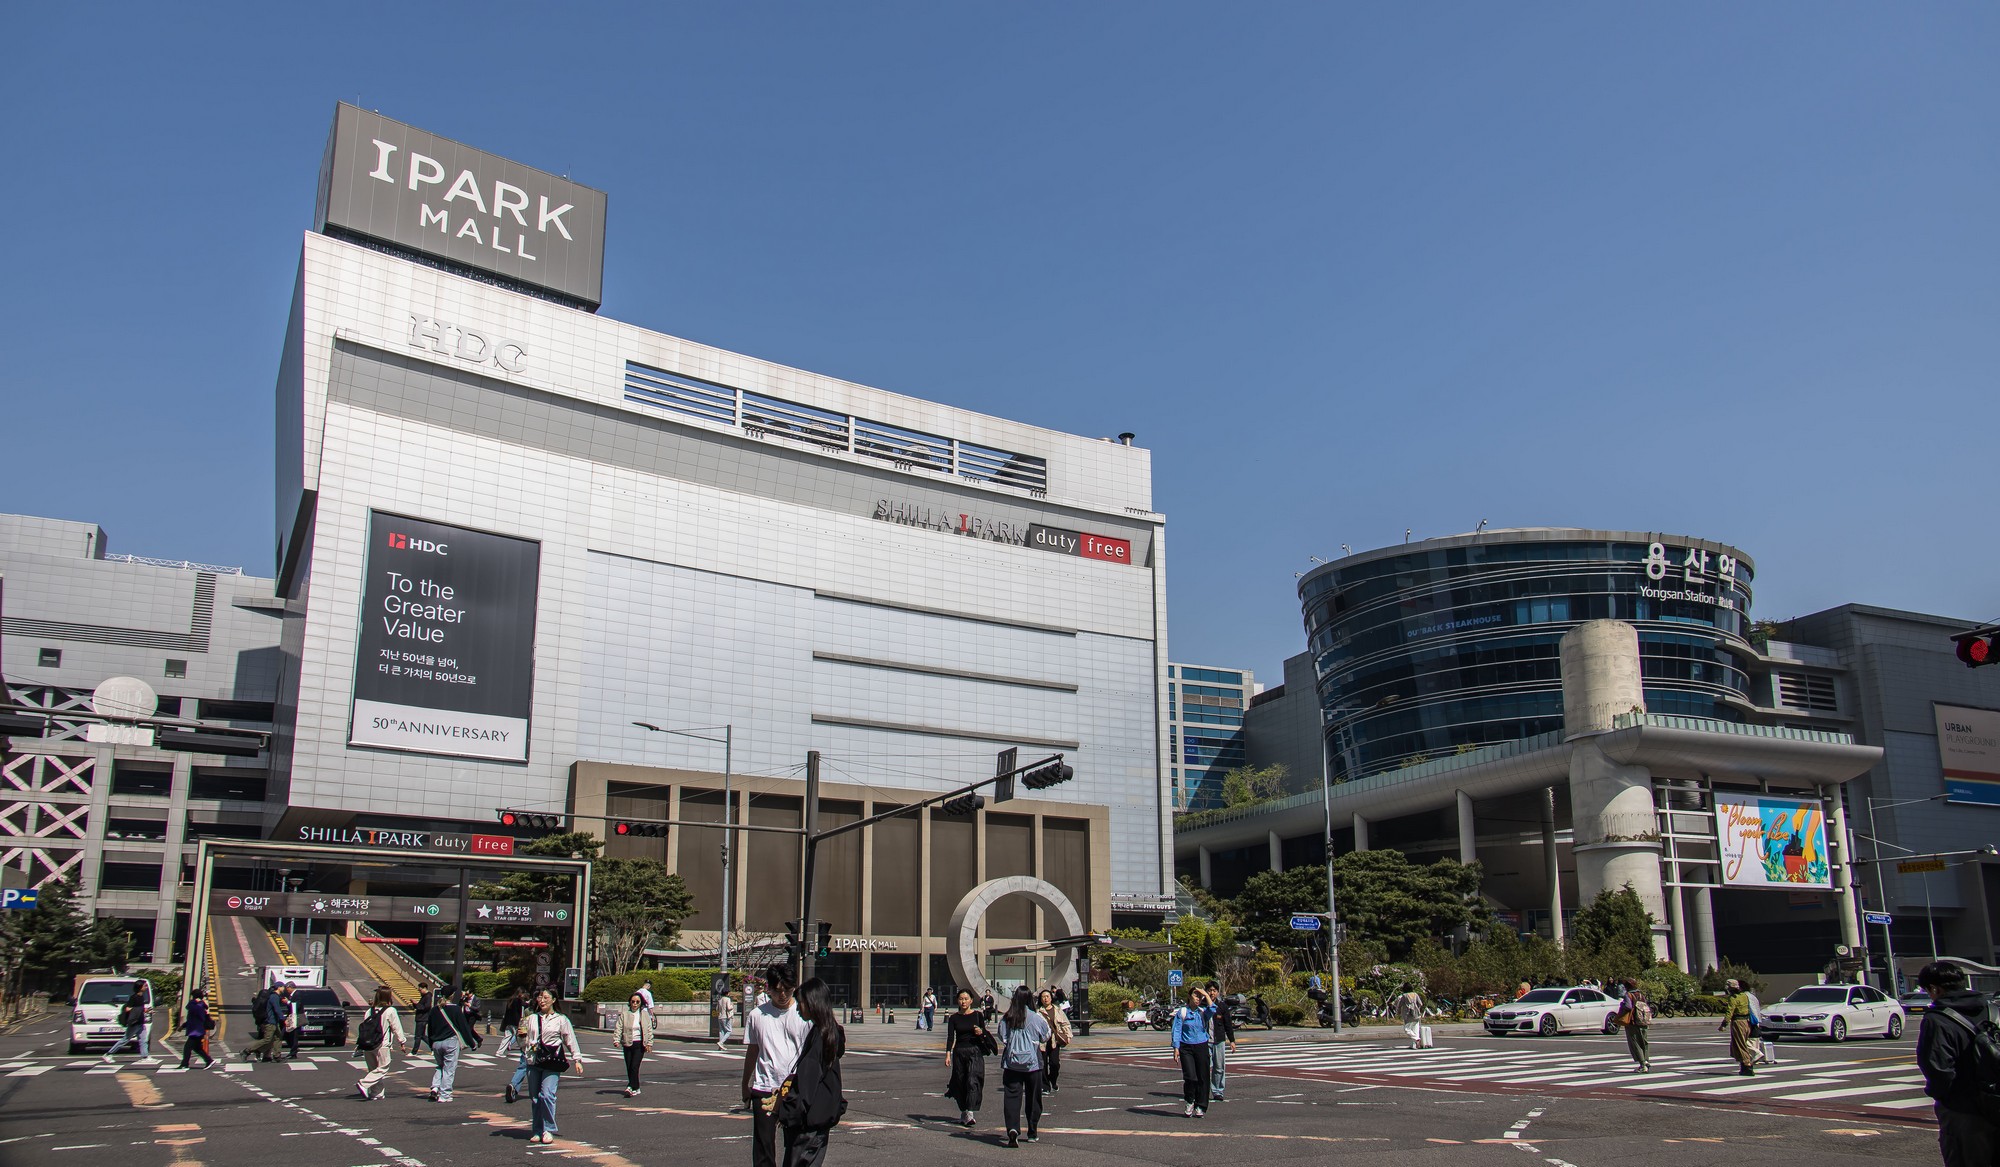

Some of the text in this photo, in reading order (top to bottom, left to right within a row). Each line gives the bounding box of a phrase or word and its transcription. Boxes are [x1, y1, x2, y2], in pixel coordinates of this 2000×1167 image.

[369, 138, 575, 242] IPARK
[419, 203, 537, 262] MALL
[408, 313, 528, 374] HDC
[875, 498, 1125, 559] SHILLA IPARK duty free
[409, 537, 449, 556] HDC
[1641, 542, 1736, 592] 용산역
[386, 571, 455, 600] To the
[1640, 585, 1714, 605] Yongsan Station
[383, 594, 466, 624] Greater
[382, 616, 445, 643] Value
[1445, 614, 1502, 630] STEAKHOUSE
[379, 648, 460, 670] 지난 50년을 넘어,
[378, 663, 477, 685] 더 큰 가치의 50년으로
[397, 719, 510, 743] ANNIVERSARY
[1944, 722, 1972, 733] URBAN
[1946, 733, 1997, 748] PLAYGROUND
[299, 826, 509, 851] SHILLA IPARK duty free
[2, 889, 20, 908] P
[244, 896, 270, 906] OUT
[330, 898, 370, 910] 해주차장
[413, 905, 425, 914] IN
[495, 905, 531, 916] 별주차장
[543, 910, 554, 919] IN
[836, 938, 877, 949] IPARK
